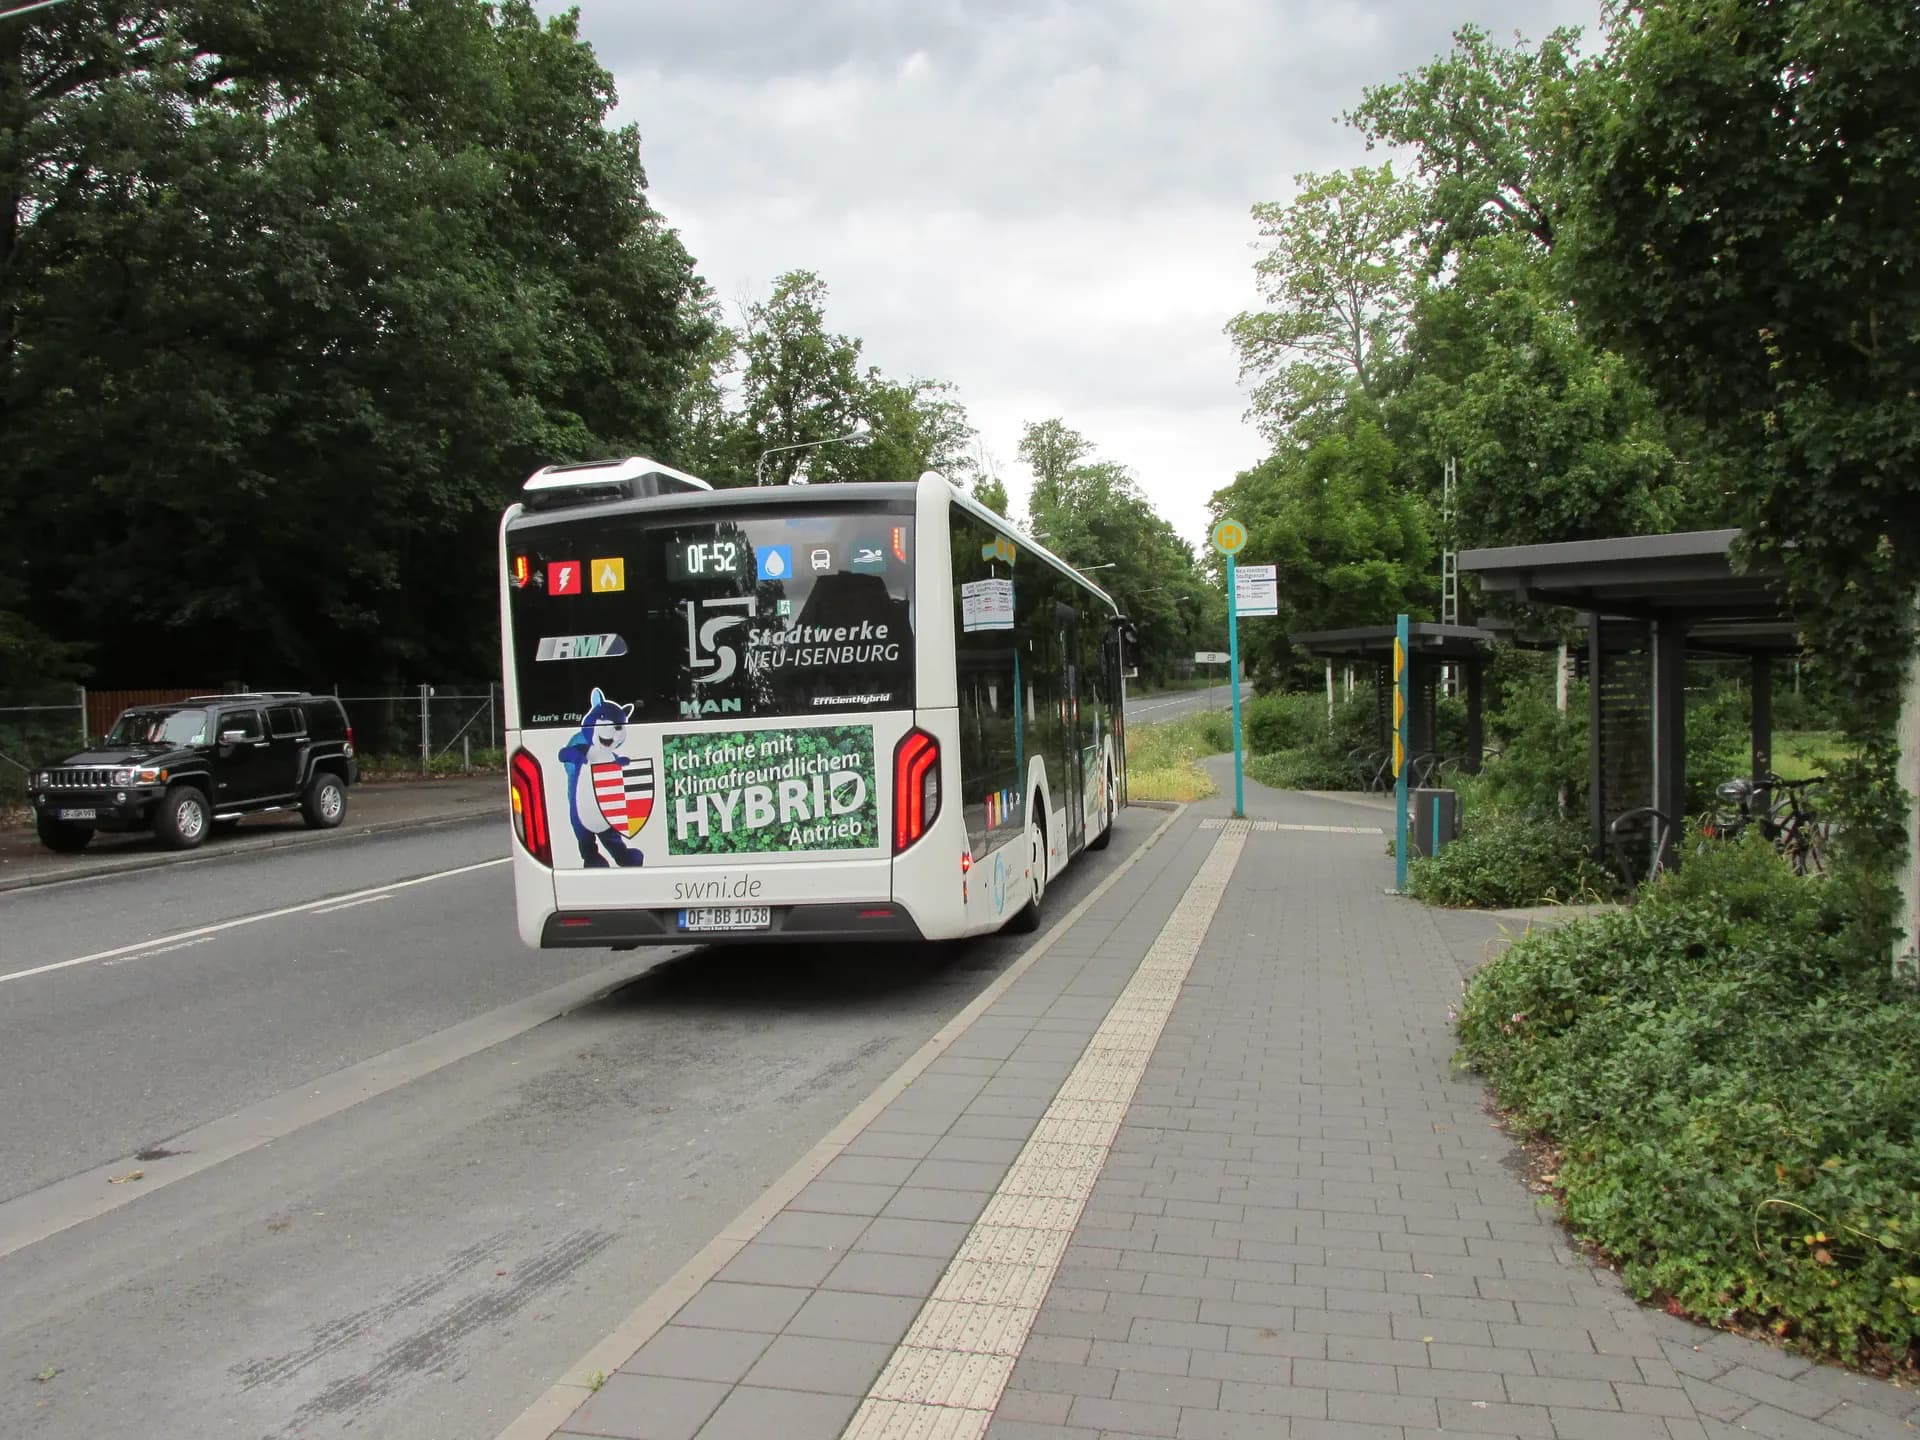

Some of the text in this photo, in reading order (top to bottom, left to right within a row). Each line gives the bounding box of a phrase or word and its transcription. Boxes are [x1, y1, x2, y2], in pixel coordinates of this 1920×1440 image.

[687, 542, 736, 573] OF-52
[552, 633, 617, 659] RMV
[748, 620, 889, 646] Stadtwerke
[744, 643, 900, 669] NEU-ISENBURG
[680, 698, 742, 714] MAN
[813, 693, 891, 705] EfficientHybrid
[532, 712, 583, 723] Lion's City
[672, 734, 793, 772] Ich fahre mit
[674, 752, 860, 797] Klimafreundlichem
[675, 770, 866, 840] HYBRID
[788, 817, 862, 846] Antrieb
[674, 873, 762, 900] swni.de
[688, 907, 768, 925] OF BB 1038
